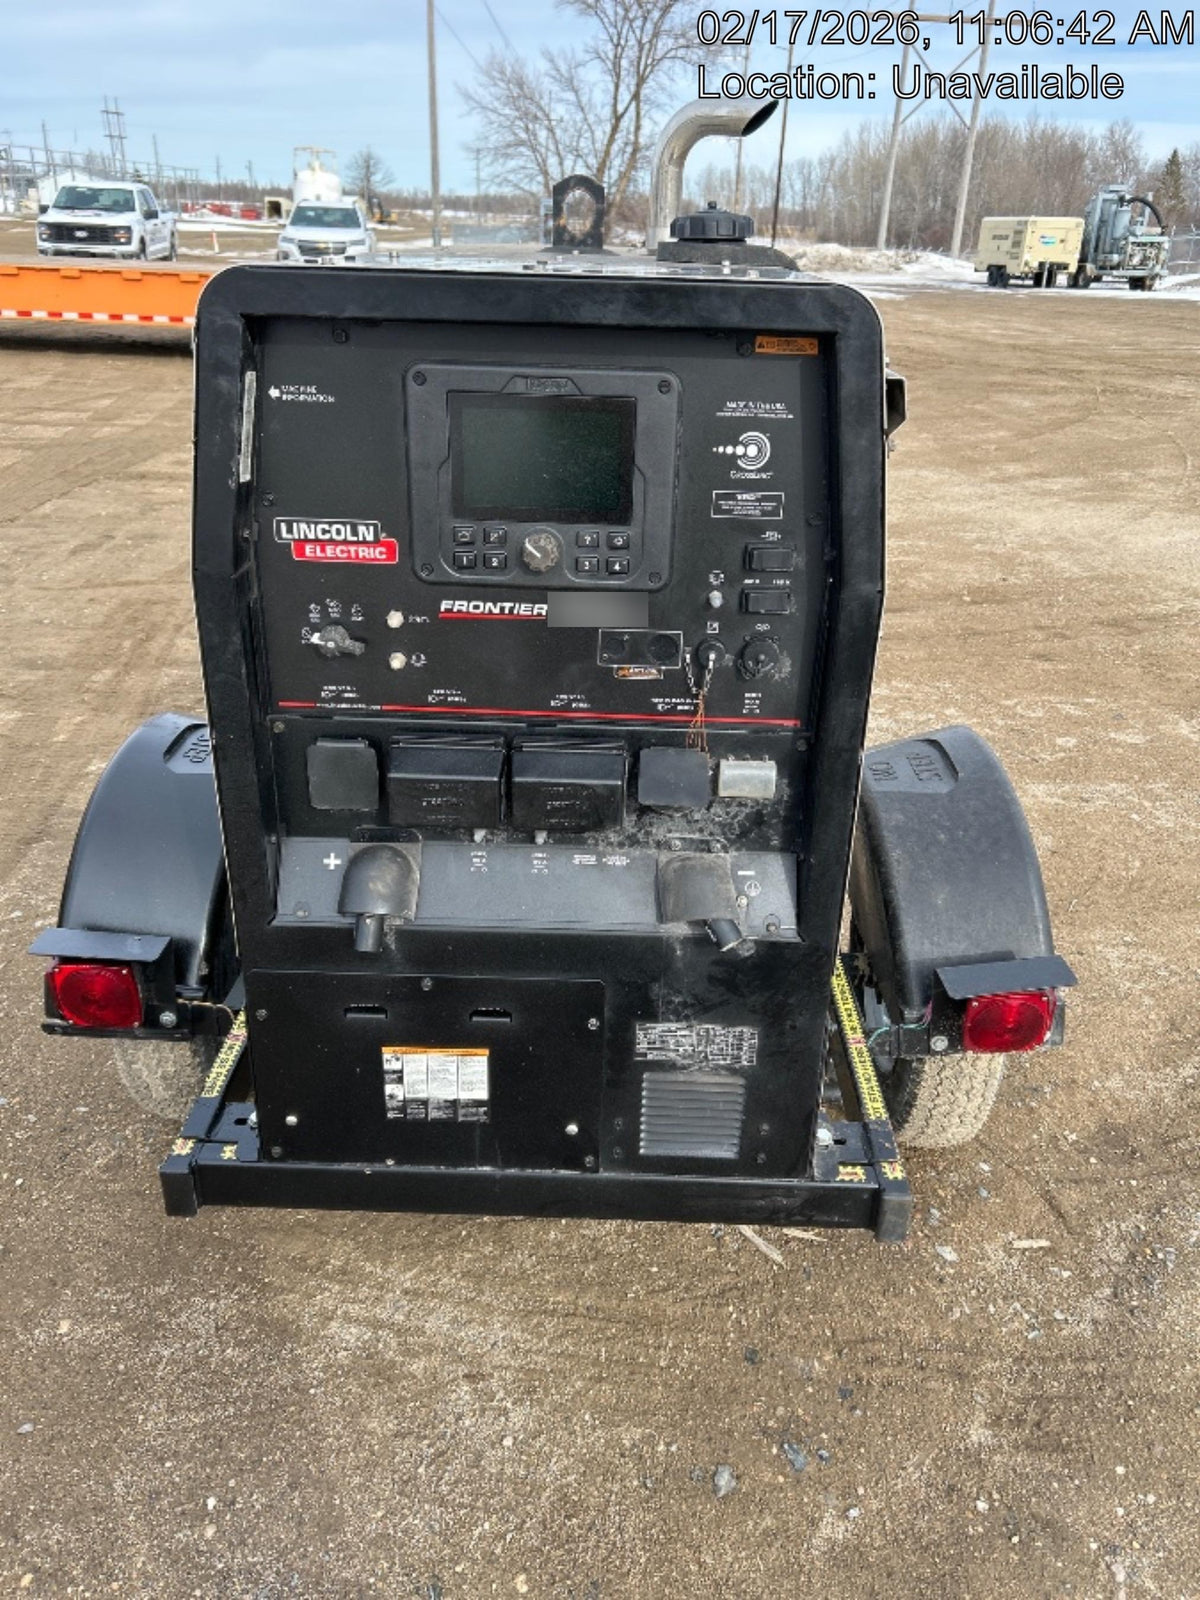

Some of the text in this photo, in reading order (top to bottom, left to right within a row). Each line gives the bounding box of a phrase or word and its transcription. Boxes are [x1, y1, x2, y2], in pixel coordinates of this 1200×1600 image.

[280, 522, 374, 541] LINCOLN
[305, 544, 388, 559] ELECTRIC
[440, 600, 548, 616] FRONTIER
